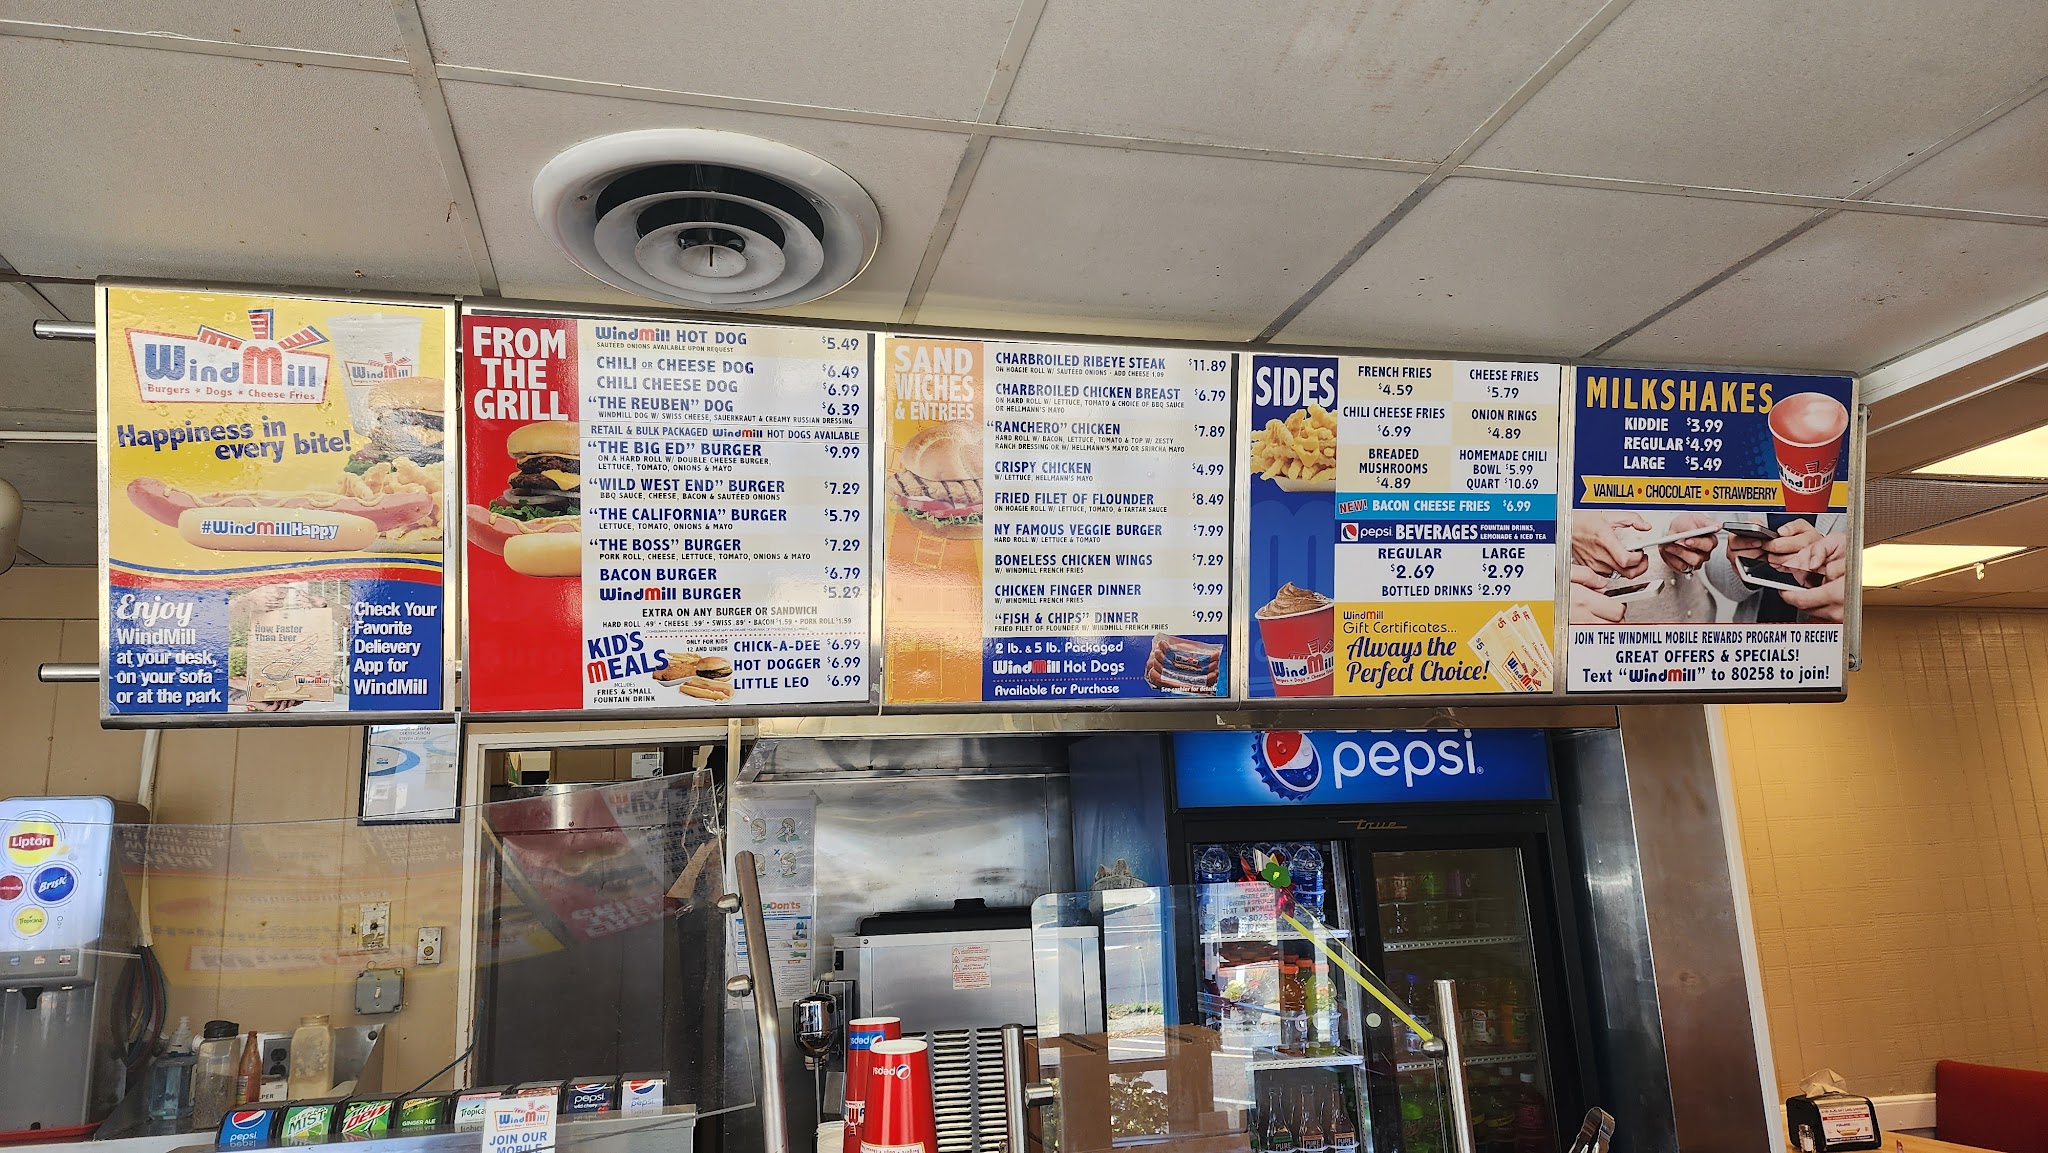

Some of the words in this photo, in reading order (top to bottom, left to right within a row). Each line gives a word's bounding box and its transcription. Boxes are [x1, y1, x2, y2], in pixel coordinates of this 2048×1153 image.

[473, 326, 566, 359] FROM
[628, 342, 652, 351] ONIONS
[654, 343, 685, 351] AVAILABLE
[706, 345, 734, 353] REQUEST
[677, 330, 711, 343] HOT
[715, 332, 747, 345] DOG
[822, 336, 859, 350] $5.49
[144, 344, 316, 387] WindMill
[895, 345, 973, 373] SAND
[996, 352, 1079, 367] CHARBROILED
[1083, 356, 1125, 368] RIBEYE
[1129, 358, 1166, 369] STEAK
[1188, 358, 1226, 372] $11.89
[480, 358, 547, 389] THE
[1358, 366, 1399, 378] FRENCH
[1402, 367, 1432, 378] FRIES
[147, 383, 190, 394] Burgers
[206, 387, 232, 397] Dogs
[248, 389, 286, 398] Cheese
[289, 391, 315, 400] Fries
[895, 374, 974, 401] WICHES
[1255, 366, 1335, 407] SIDES
[1378, 383, 1413, 396] $4.59
[1586, 376, 1773, 414] MILKSHAKES
[474, 391, 568, 420] GRILL
[895, 404, 905, 419] &
[910, 403, 974, 421] ENTREES
[1472, 409, 1505, 420] ONION
[1507, 410, 1537, 421] RINGS
[117, 421, 254, 450] Happiness
[262, 416, 286, 437] in
[1624, 417, 1669, 431] KIDDIE
[1686, 418, 1723, 433] $3.99
[1487, 427, 1521, 440] $4.89
[215, 441, 284, 463] every
[294, 430, 350, 455] bite!
[1624, 437, 1684, 451] REGULAR
[1686, 437, 1723, 452] $4.99
[1623, 456, 1665, 470] LARGE
[1685, 456, 1722, 471] $5.49
[995, 493, 1030, 505] FRIED
[1035, 493, 1067, 504] FILET
[1072, 494, 1088, 504] OF
[1093, 494, 1154, 505] FLOUNDER
[1192, 493, 1224, 505] $8.49
[1593, 484, 1634, 498] VANILLA
[1646, 484, 1701, 499] CHOCOLATE
[1713, 487, 1777, 500] STRAWBERRY
[1339, 498, 1368, 514] NEW!
[1373, 500, 1409, 511] BACON
[1414, 500, 1456, 511] CHEESE
[1460, 500, 1490, 511] FRIES
[1503, 499, 1530, 512] $6.99
[201, 519, 338, 540] #WindMillHappy
[1361, 526, 1393, 538] pepsi
[1396, 524, 1478, 541] BEVERAGES
[600, 569, 651, 580] BACON
[656, 568, 716, 580] BURGER
[824, 566, 860, 580] $6.79
[117, 594, 193, 627] Enjoy
[355, 602, 400, 617] Check
[405, 602, 437, 617] Your
[276, 625, 302, 634] Faster
[355, 621, 412, 635] Favorite
[117, 629, 196, 645] WindMill
[255, 634, 275, 642] Than
[278, 634, 296, 642] Ever
[1575, 632, 1594, 645] JOIN
[1598, 632, 1614, 644] THE
[1619, 632, 1662, 644] WINDMILL
[1665, 632, 1698, 644] MOBILE
[1702, 632, 1742, 644] REWARDS
[1746, 631, 1787, 644] PROGRAM
[1791, 631, 1801, 643] TO
[1804, 630, 1838, 643] RECEIVE
[355, 640, 420, 656] Delievery
[588, 631, 644, 660] KID'S
[1347, 636, 1422, 664] Always
[1427, 637, 1457, 656] the
[117, 651, 133, 664] at
[137, 652, 171, 667] your
[174, 652, 217, 667] desk,
[354, 660, 383, 675] App
[387, 660, 408, 672] for
[1346, 660, 1413, 688] Perfect
[1420, 661, 1491, 681] Choice!
[1583, 669, 1612, 682] Text
[1711, 668, 1725, 680] to
[1731, 667, 1774, 680] 80258
[1780, 667, 1794, 680] to
[1799, 666, 1829, 683] join!
[116, 671, 137, 684] on
[140, 671, 175, 686] your
[179, 670, 212, 683] sofa
[354, 679, 427, 695] WindMill
[116, 691, 133, 703] or
[137, 691, 153, 704] at
[157, 690, 182, 703] the
[185, 690, 221, 705] park
[1332, 728, 1477, 790] pepsi
[12, 835, 50, 848] Lipton
[850, 1036, 869, 1044] peps
[574, 1094, 605, 1104] pepsi
[631, 1098, 655, 1108] pepsi
[461, 1104, 486, 1117] Tropica
[499, 1112, 546, 1124] WindMill
[288, 1112, 326, 1135] MIST
[230, 1132, 257, 1141] pepsi
[489, 1133, 517, 1145] JOIN
[522, 1131, 547, 1142] OUR
